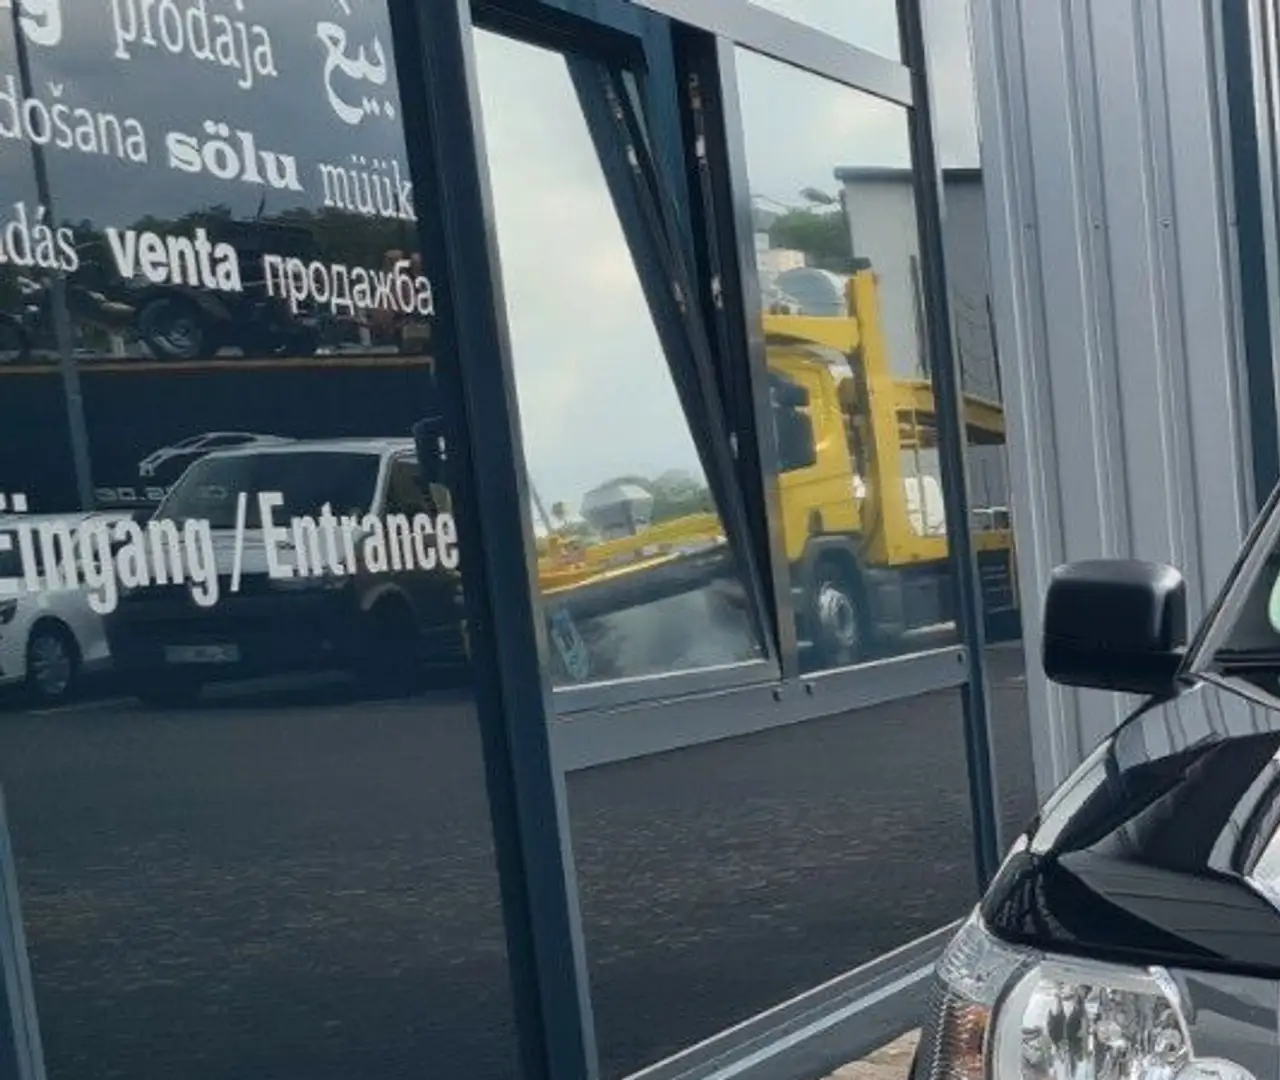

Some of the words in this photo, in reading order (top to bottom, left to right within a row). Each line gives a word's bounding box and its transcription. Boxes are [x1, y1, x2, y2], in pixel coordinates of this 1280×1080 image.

[112, 0, 279, 89] prodaja
[165, 120, 303, 192] sölu
[318, 155, 417, 219] müük
[0, 201, 79, 273] dás
[105, 227, 243, 292] venta
[263, 254, 435, 316] продажба
[258, 491, 461, 579] Entrance
